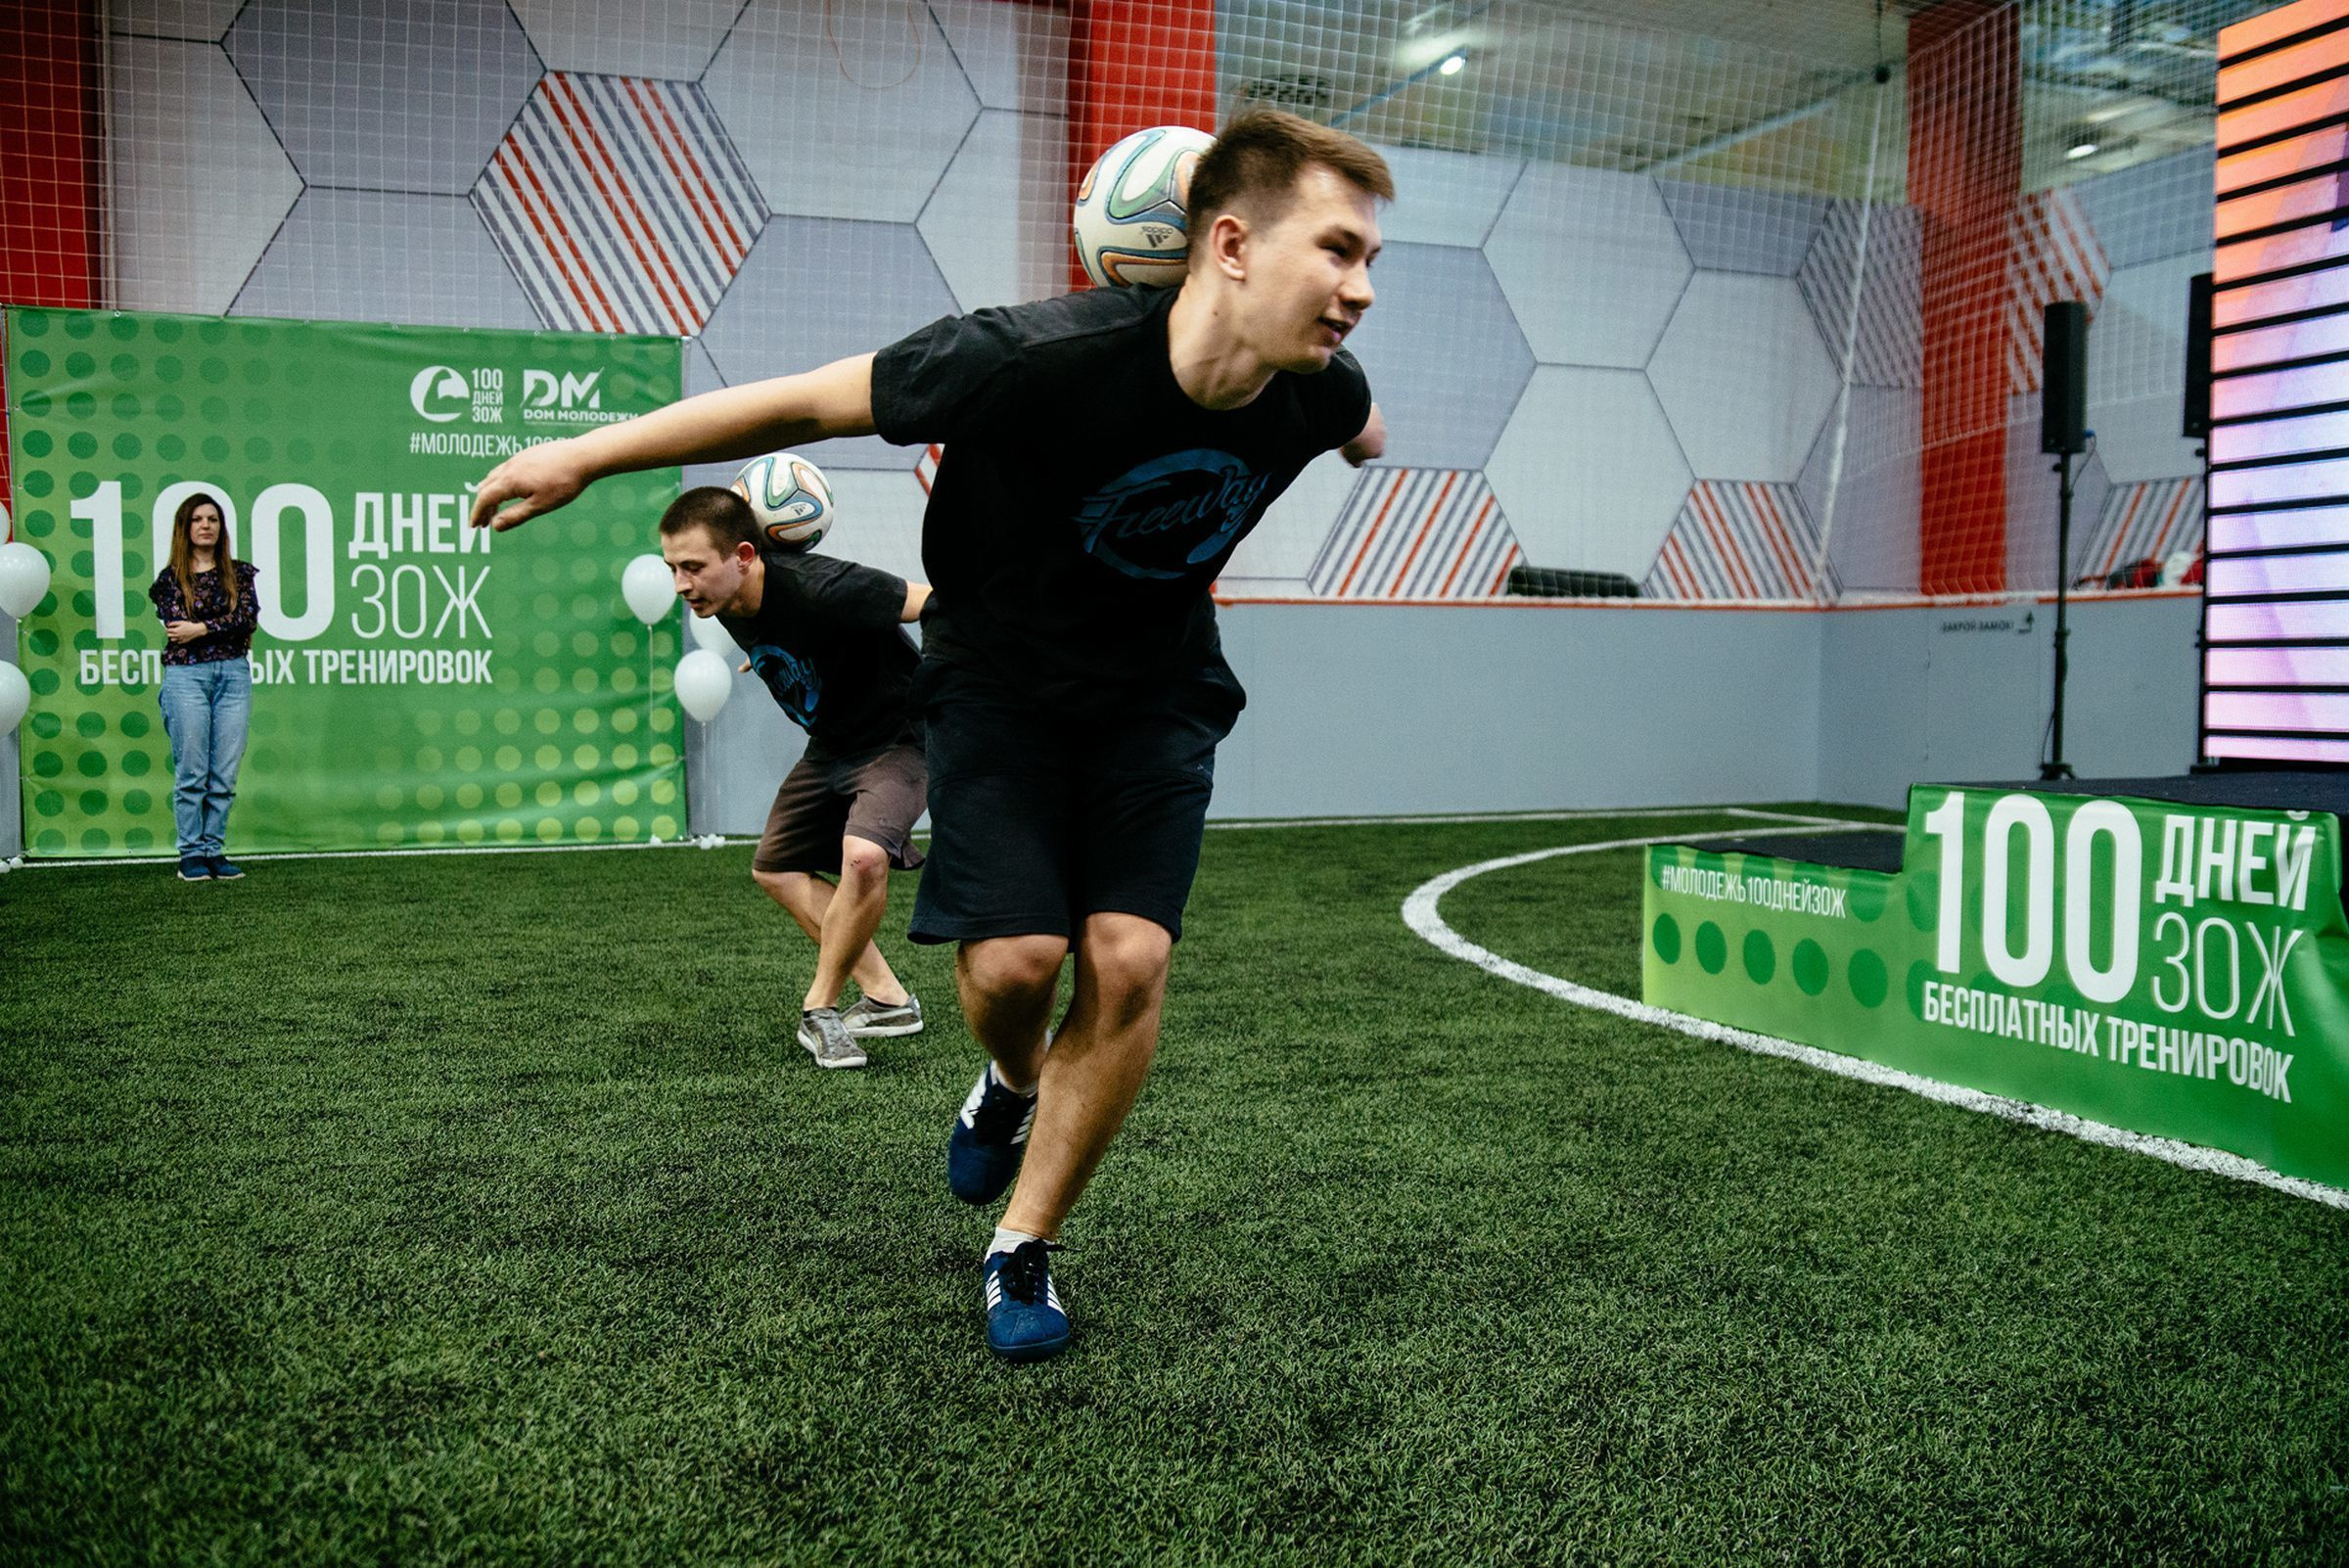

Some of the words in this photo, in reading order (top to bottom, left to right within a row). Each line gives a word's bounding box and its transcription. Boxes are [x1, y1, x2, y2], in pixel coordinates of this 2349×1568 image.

[472, 368, 503, 390] 100
[472, 389, 503, 405] ДНЕЙ
[472, 406, 503, 423] ЗОЖ
[348, 482, 491, 559] ДНЕЙ
[351, 564, 492, 639] ЗОЖ
[80, 649, 296, 684] БЕСПЫХ
[302, 649, 493, 684] ТРЕНИРОВОК
[1923, 791, 2142, 1003] 100
[2155, 810, 2316, 911] ДНЕЙ
[2152, 912, 2304, 1037] ЗОЖ
[1924, 981, 2099, 1057] БЕСПЛАТНЫХ
[2105, 1015, 2294, 1104] ТРЕНИРОВОК
